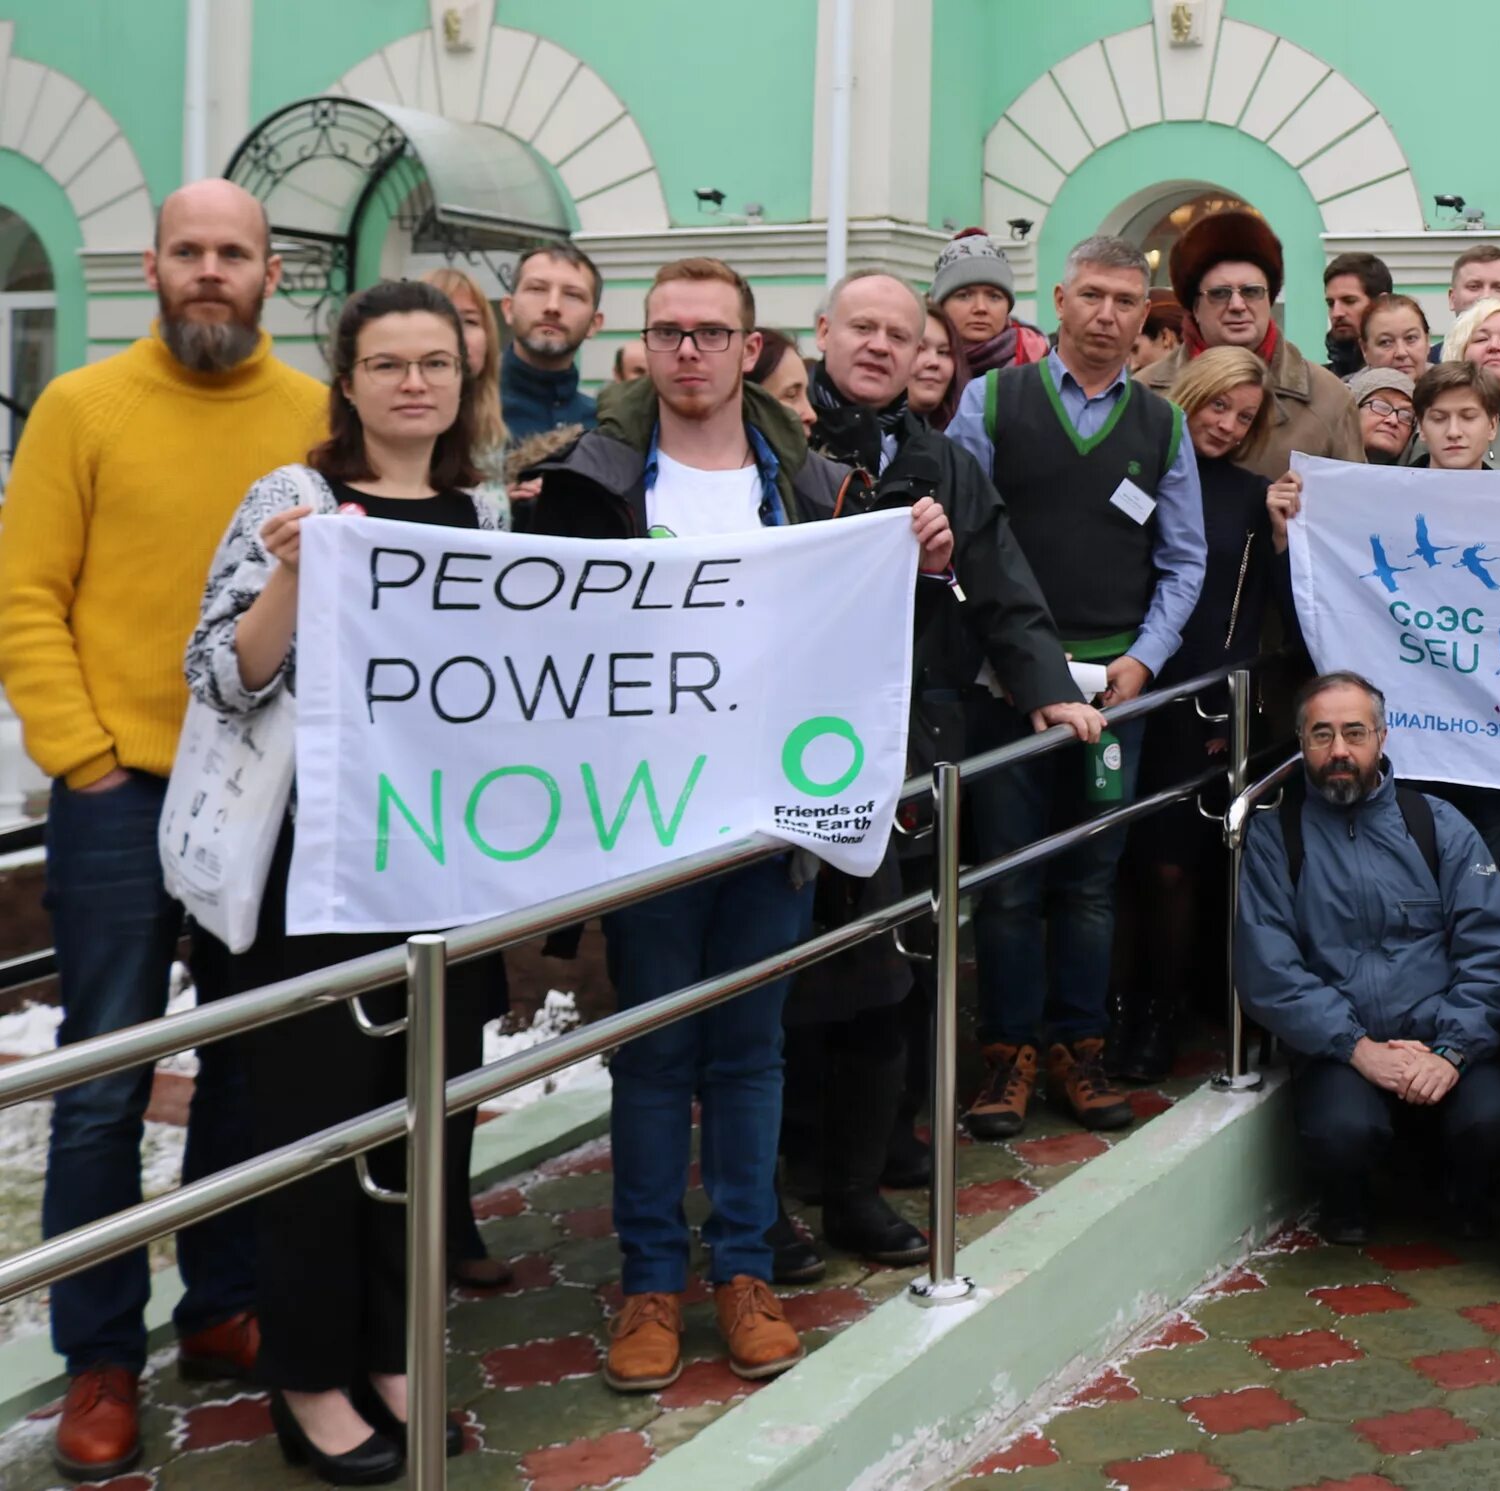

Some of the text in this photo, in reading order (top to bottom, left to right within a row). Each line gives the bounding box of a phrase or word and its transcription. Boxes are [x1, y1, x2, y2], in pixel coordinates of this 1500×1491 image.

[370, 547, 746, 611] PEOPLE.
[1389, 601, 1484, 635] СоЭС
[1400, 632, 1479, 674] SEU
[366, 651, 738, 724] POWER.
[375, 754, 731, 872] NOW.
[774, 800, 875, 818] Friends of
[816, 816, 871, 831] Earth
